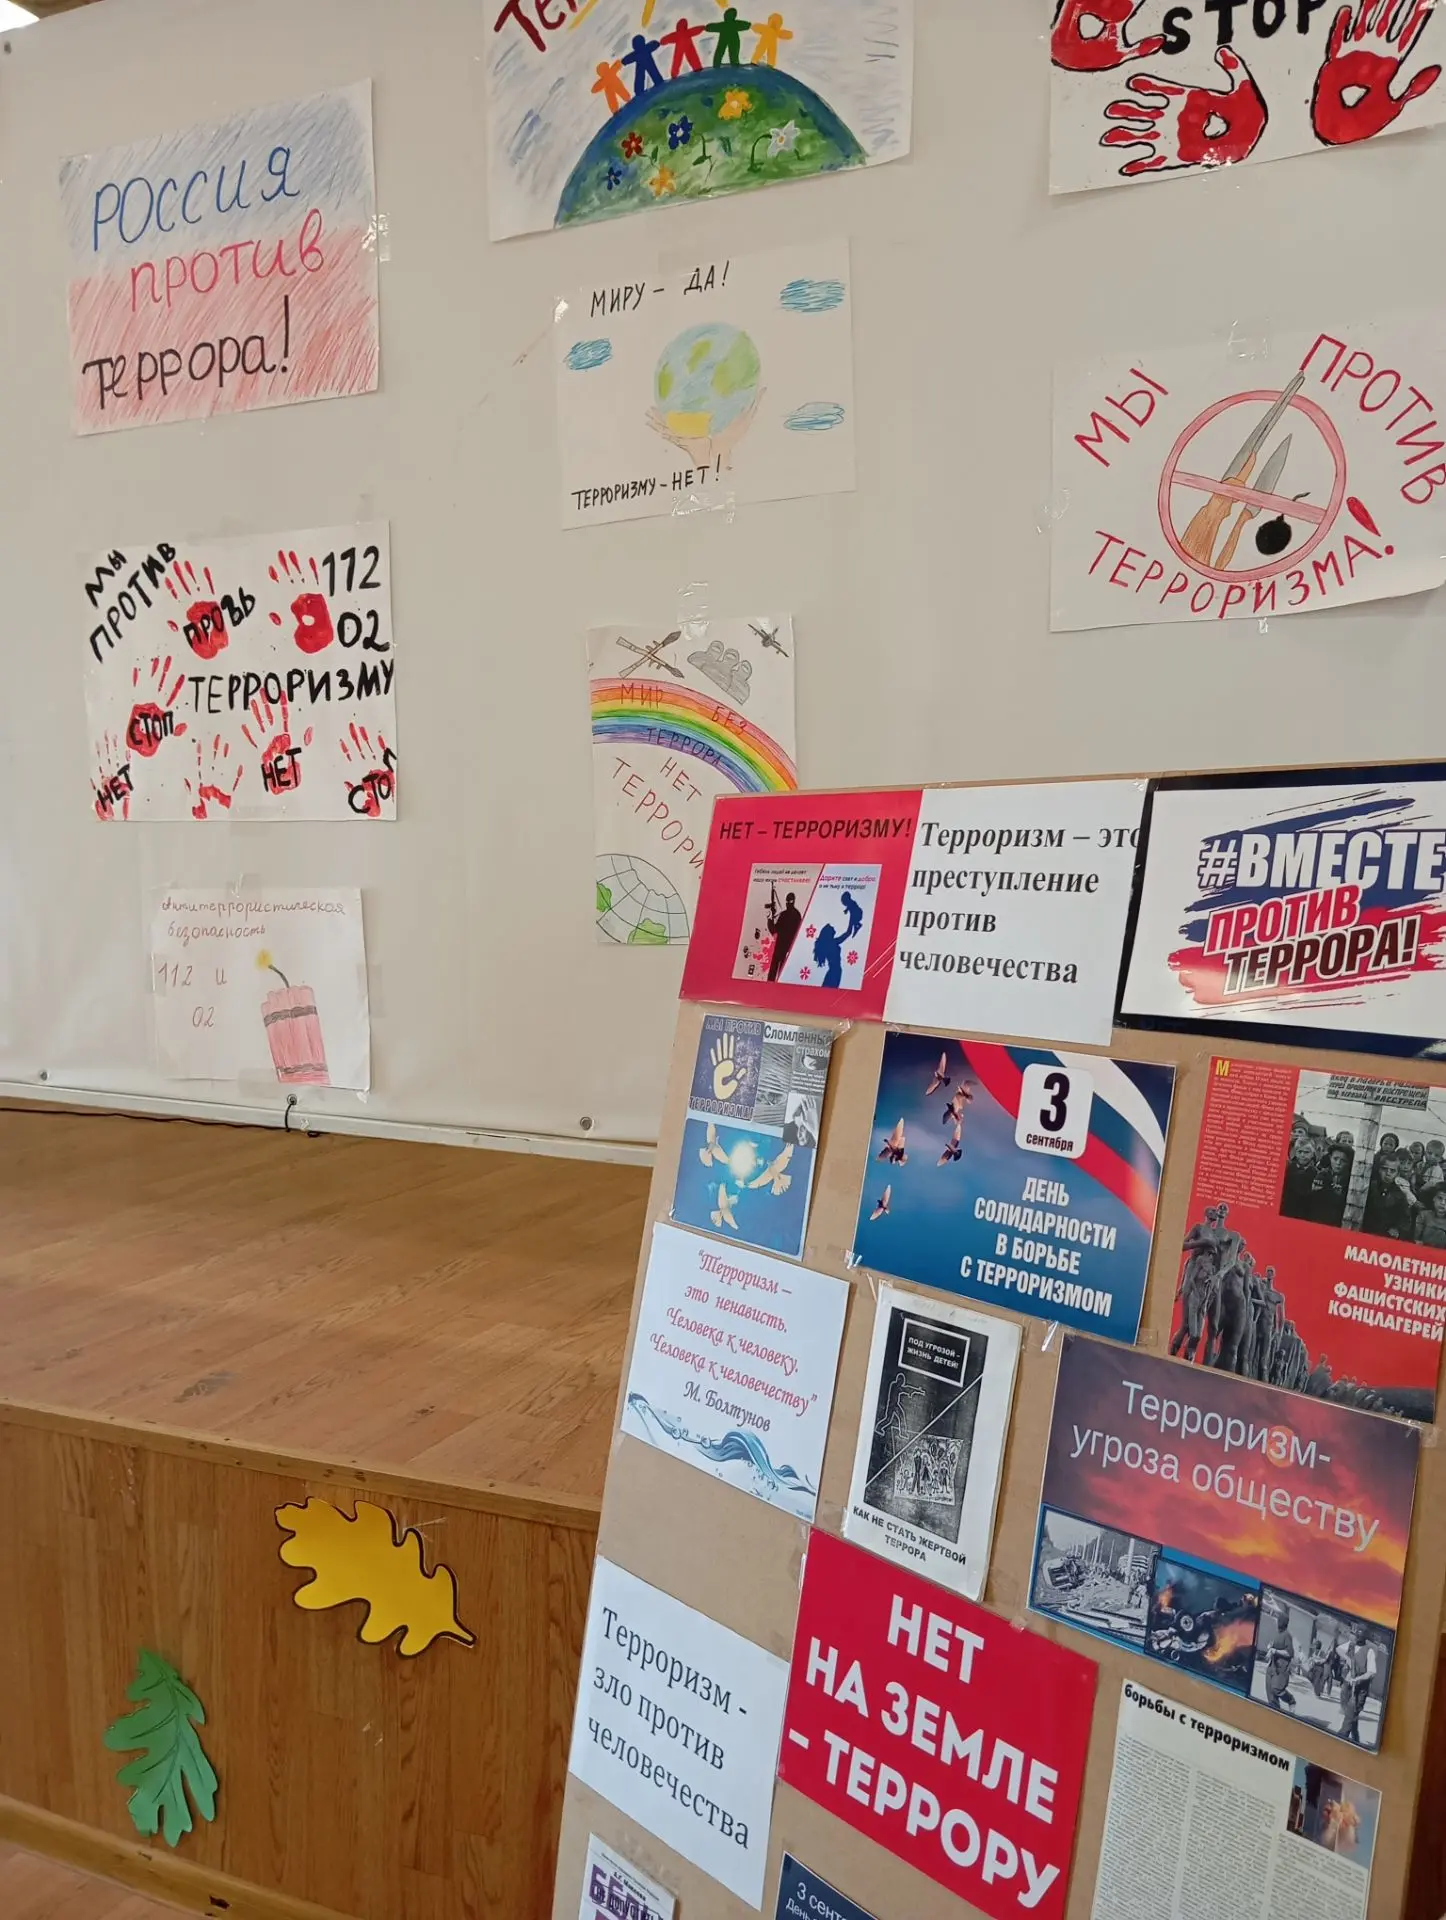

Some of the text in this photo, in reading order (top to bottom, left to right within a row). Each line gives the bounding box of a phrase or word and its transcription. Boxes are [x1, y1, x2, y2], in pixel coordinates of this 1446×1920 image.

[1162, 0, 1327, 54] STOP
[92, 146, 300, 251] РОССИЯ
[590, 282, 646, 317] МИРУ
[684, 260, 729, 295] ДА!
[1074, 333, 1446, 504] МЫ ПРОТИВ
[322, 545, 381, 596] 112
[1087, 496, 1394, 619] ТЕРРОРИЗМА!
[90, 543, 176, 664] ПРОТИВ
[337, 610, 390, 651] 02
[188, 659, 395, 713] ТЕРРОРИЗМУ
[620, 683, 663, 709] МИР
[130, 711, 174, 747] СТОП
[711, 706, 747, 737] БЕЗ
[261, 747, 302, 792] НЕТ
[646, 727, 723, 766] ТЕРРОРА
[97, 763, 135, 811] НЕТ
[659, 757, 702, 802] НЕТ
[611, 757, 704, 870] ТЕРРОРИ
[720, 822, 754, 839] НЕТ
[773, 818, 912, 839] ТЕРРОРИЗМУ!
[921, 822, 1066, 855] Терроризм
[1197, 831, 1446, 891] #ВМЕСТЕ
[911, 868, 1100, 897] преступление
[904, 909, 997, 936] против
[1203, 883, 1363, 956] ПРОТИВ
[158, 962, 193, 987] 112
[899, 950, 1078, 984] человечества
[1223, 915, 1421, 996] ТЕРРОРА!
[192, 1006, 215, 1028] 02
[1039, 1072, 1070, 1132] 3
[1026, 1132, 1073, 1152] сентября
[1022, 1176, 1070, 1207] ДЕНЬ
[974, 1197, 1117, 1251] СОЛИДАРНОСТИ
[995, 1233, 1082, 1275] В БОРЬБЕ
[1344, 1245, 1446, 1281] МАЛОЛЕТНИ
[684, 1285, 787, 1333] это ненависть.
[960, 1255, 1113, 1318] С ТЕРРОРИЗМОМ
[1333, 1282, 1446, 1322] ФАШИСТСКИХ
[666, 1307, 798, 1376] Человека к человеку.
[1328, 1300, 1444, 1342] КОНЦЛАГЕРЕЙ
[650, 1333, 706, 1372] Человека
[708, 1361, 719, 1381] к
[906, 1347, 932, 1360] ЖИЗНЬ
[908, 1336, 924, 1348] ПОД
[925, 1342, 956, 1357] УГРОЗОЙ
[683, 1381, 771, 1432] М. Болтунов
[1122, 1380, 1331, 1470] Терроризм-
[1070, 1425, 1380, 1552] угроза обществу
[853, 1506, 967, 1565] КАК НЕ СТАТЬ ЖЕРТВОЙ
[885, 1534, 926, 1562] ТЕРРОРА
[602, 1607, 732, 1715] Терроризм
[887, 1593, 984, 1685] НЕТ
[593, 1666, 724, 1770] зло против
[805, 1636, 1059, 1825] НА ЗЕМЛЕ
[1124, 1683, 1290, 1772] борьбы с терроризмом
[588, 1717, 749, 1850] человечества
[823, 1728, 1060, 1909] ТЕРРОРУ
[797, 1882, 849, 1920] 3 сент
